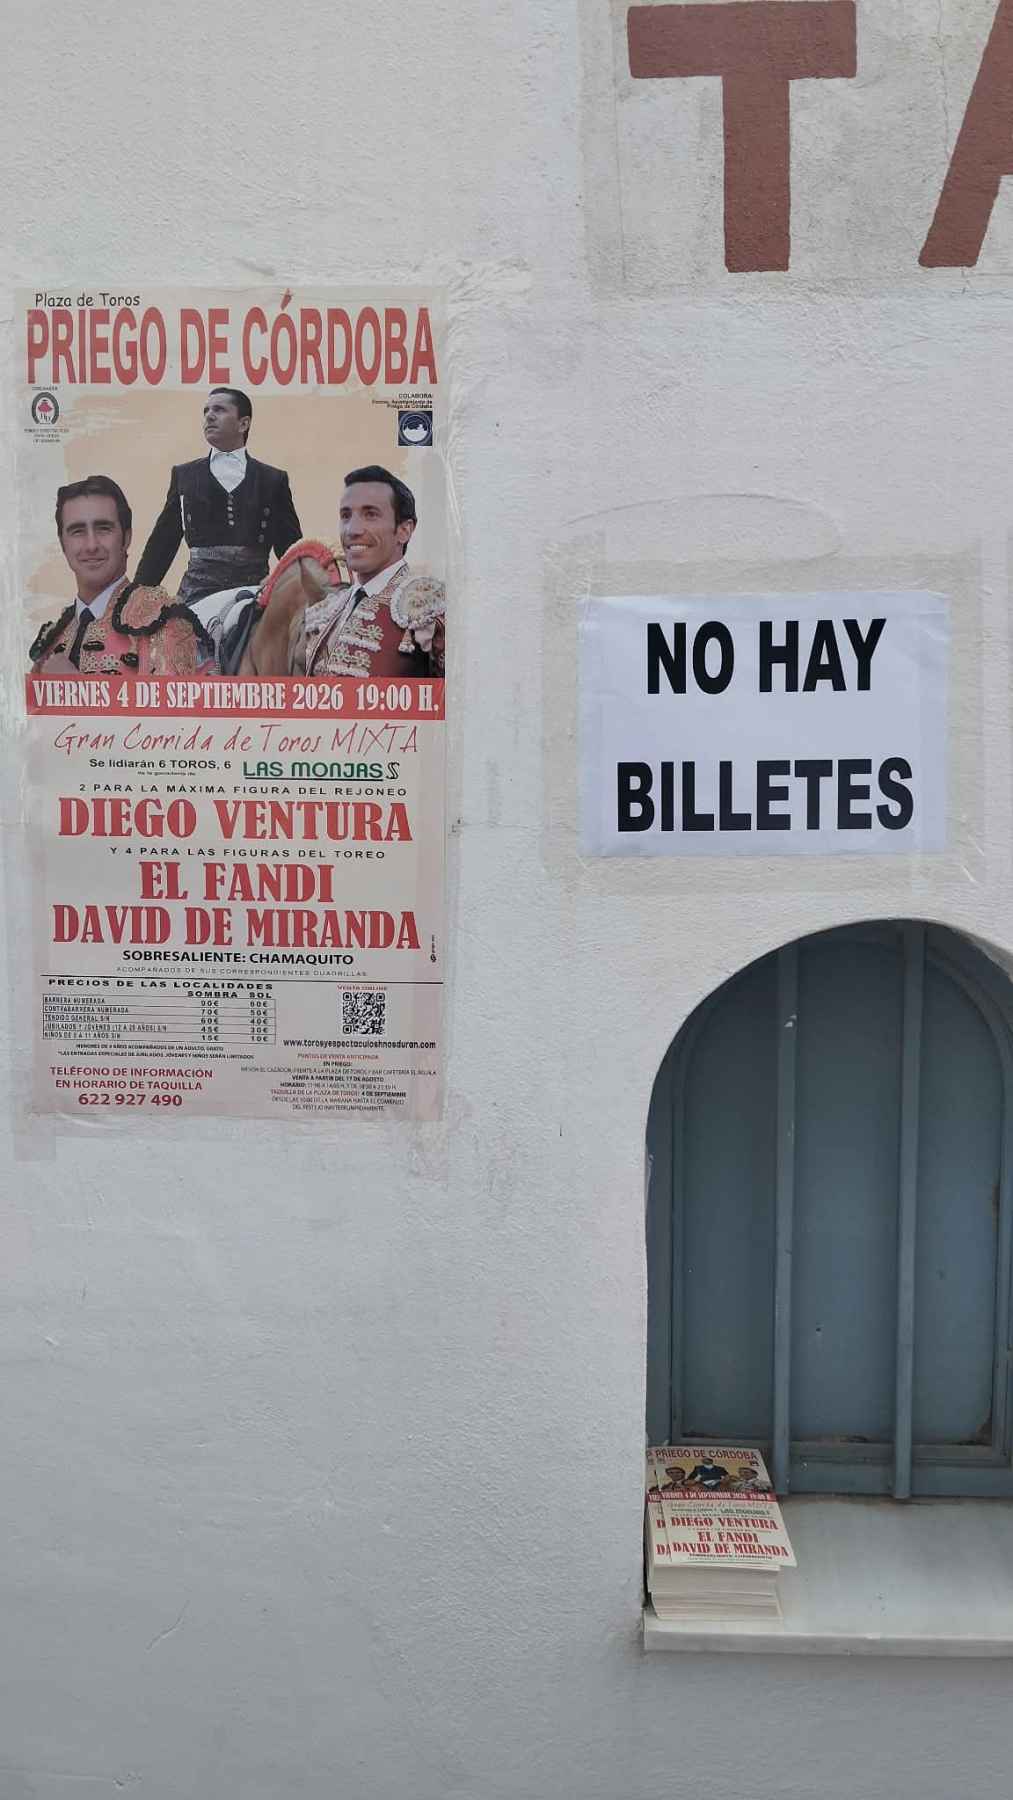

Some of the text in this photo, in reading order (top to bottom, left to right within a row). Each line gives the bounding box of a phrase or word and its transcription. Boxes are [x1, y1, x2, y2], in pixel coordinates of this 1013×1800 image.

[35, 293, 140, 308] Plaza de Toros
[26, 288, 439, 386] PRIEGO DE CÓRDOBA
[647, 618, 887, 695] NO HAY
[32, 680, 440, 712] VIERNES 4 DE SEPTIEMBRE 2026 19:00 H.
[54, 722, 419, 756] Gran Corrida de Toros MIXTA
[89, 758, 105, 768] Se
[109, 759, 155, 768] lidiarán
[158, 760, 166, 768] 6
[169, 760, 220, 771] TOROS,
[224, 760, 232, 769] 6
[243, 761, 284, 777] LAS
[291, 761, 384, 778] MONJAS
[79, 784, 86, 792] 2
[94, 784, 134, 792] PARA
[166, 782, 226, 793] MÁXIMA
[234, 786, 291, 794] FIGURA
[298, 787, 327, 795] DEL
[334, 787, 407, 796] REJONEO
[616, 757, 915, 832] BILLETES
[58, 797, 413, 842] DIEGO VENTURA
[140, 848, 179, 856] PARA
[187, 849, 217, 857] LAS
[224, 849, 290, 858] FIGURAS
[298, 850, 326, 858] DEL
[334, 850, 386, 859] TOREO
[138, 861, 335, 903] EL FANDI
[52, 905, 172, 945] DAVID
[184, 906, 233, 947] DE
[246, 908, 421, 950] MIRANDA
[122, 950, 354, 965] SOBRESALIENTE: CHAMAQUITO
[48, 979, 110, 987] PRECIOS
[140, 980, 167, 988] LAS
[173, 981, 273, 990] LOCALIDADES
[50, 1065, 110, 1077] TELÉFONO
[112, 1067, 128, 1077] DE
[55, 1080, 203, 1091] EN HORARIO DE TAQUILLA
[78, 1093, 183, 1107] 622 927 490
[671, 1517, 714, 1527] DIEGO
[718, 1518, 779, 1530] VENTURA
[697, 1531, 759, 1544] EL FANDI
[672, 1542, 711, 1554] DAVID
[713, 1543, 731, 1554] DE
[733, 1543, 789, 1557] MIRANDA
